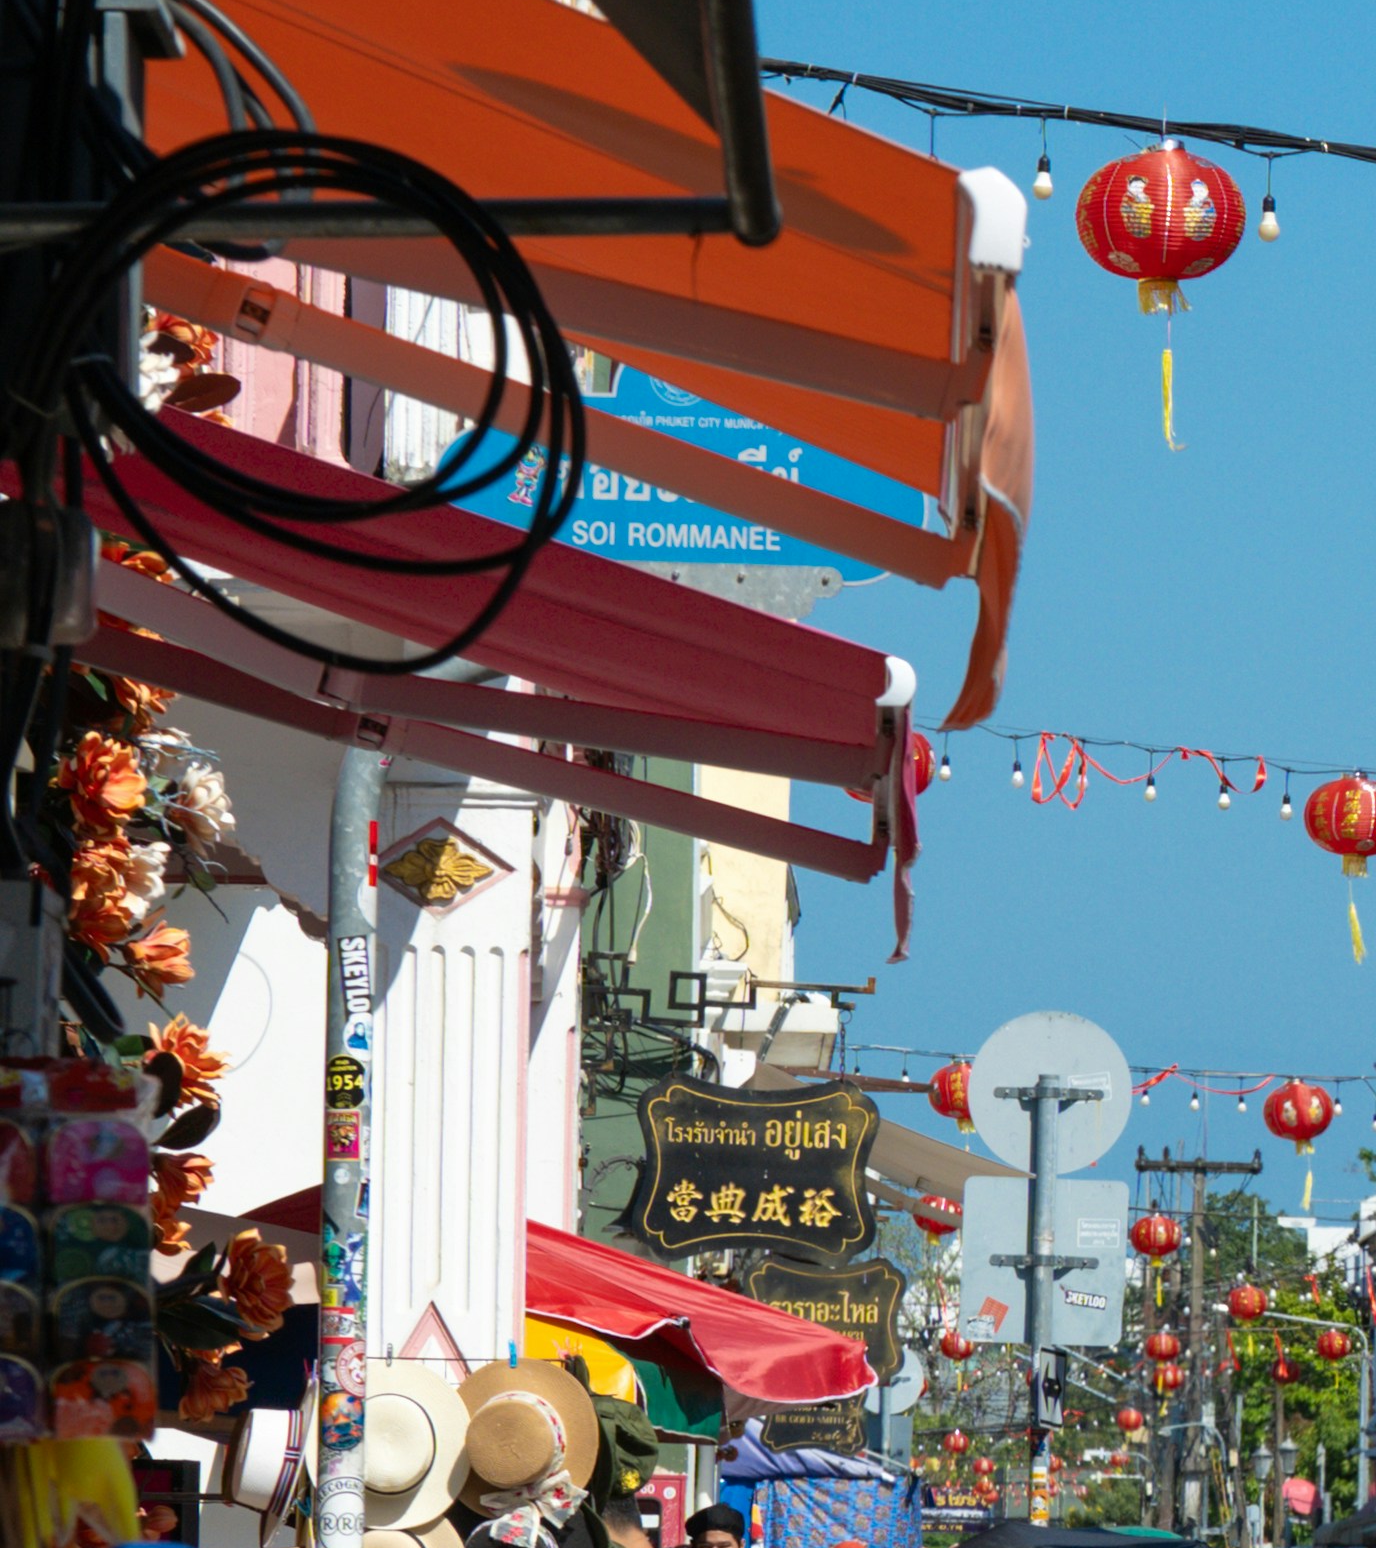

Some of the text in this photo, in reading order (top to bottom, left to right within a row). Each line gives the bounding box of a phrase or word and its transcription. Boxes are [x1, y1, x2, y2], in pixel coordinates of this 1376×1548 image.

[656, 415, 694, 427] PHUKET
[698, 417, 720, 428] CITY
[572, 520, 782, 551] SOI ROMMANEE
[340, 937, 371, 1013] SKEYLO
[326, 1075, 364, 1092] 1954
